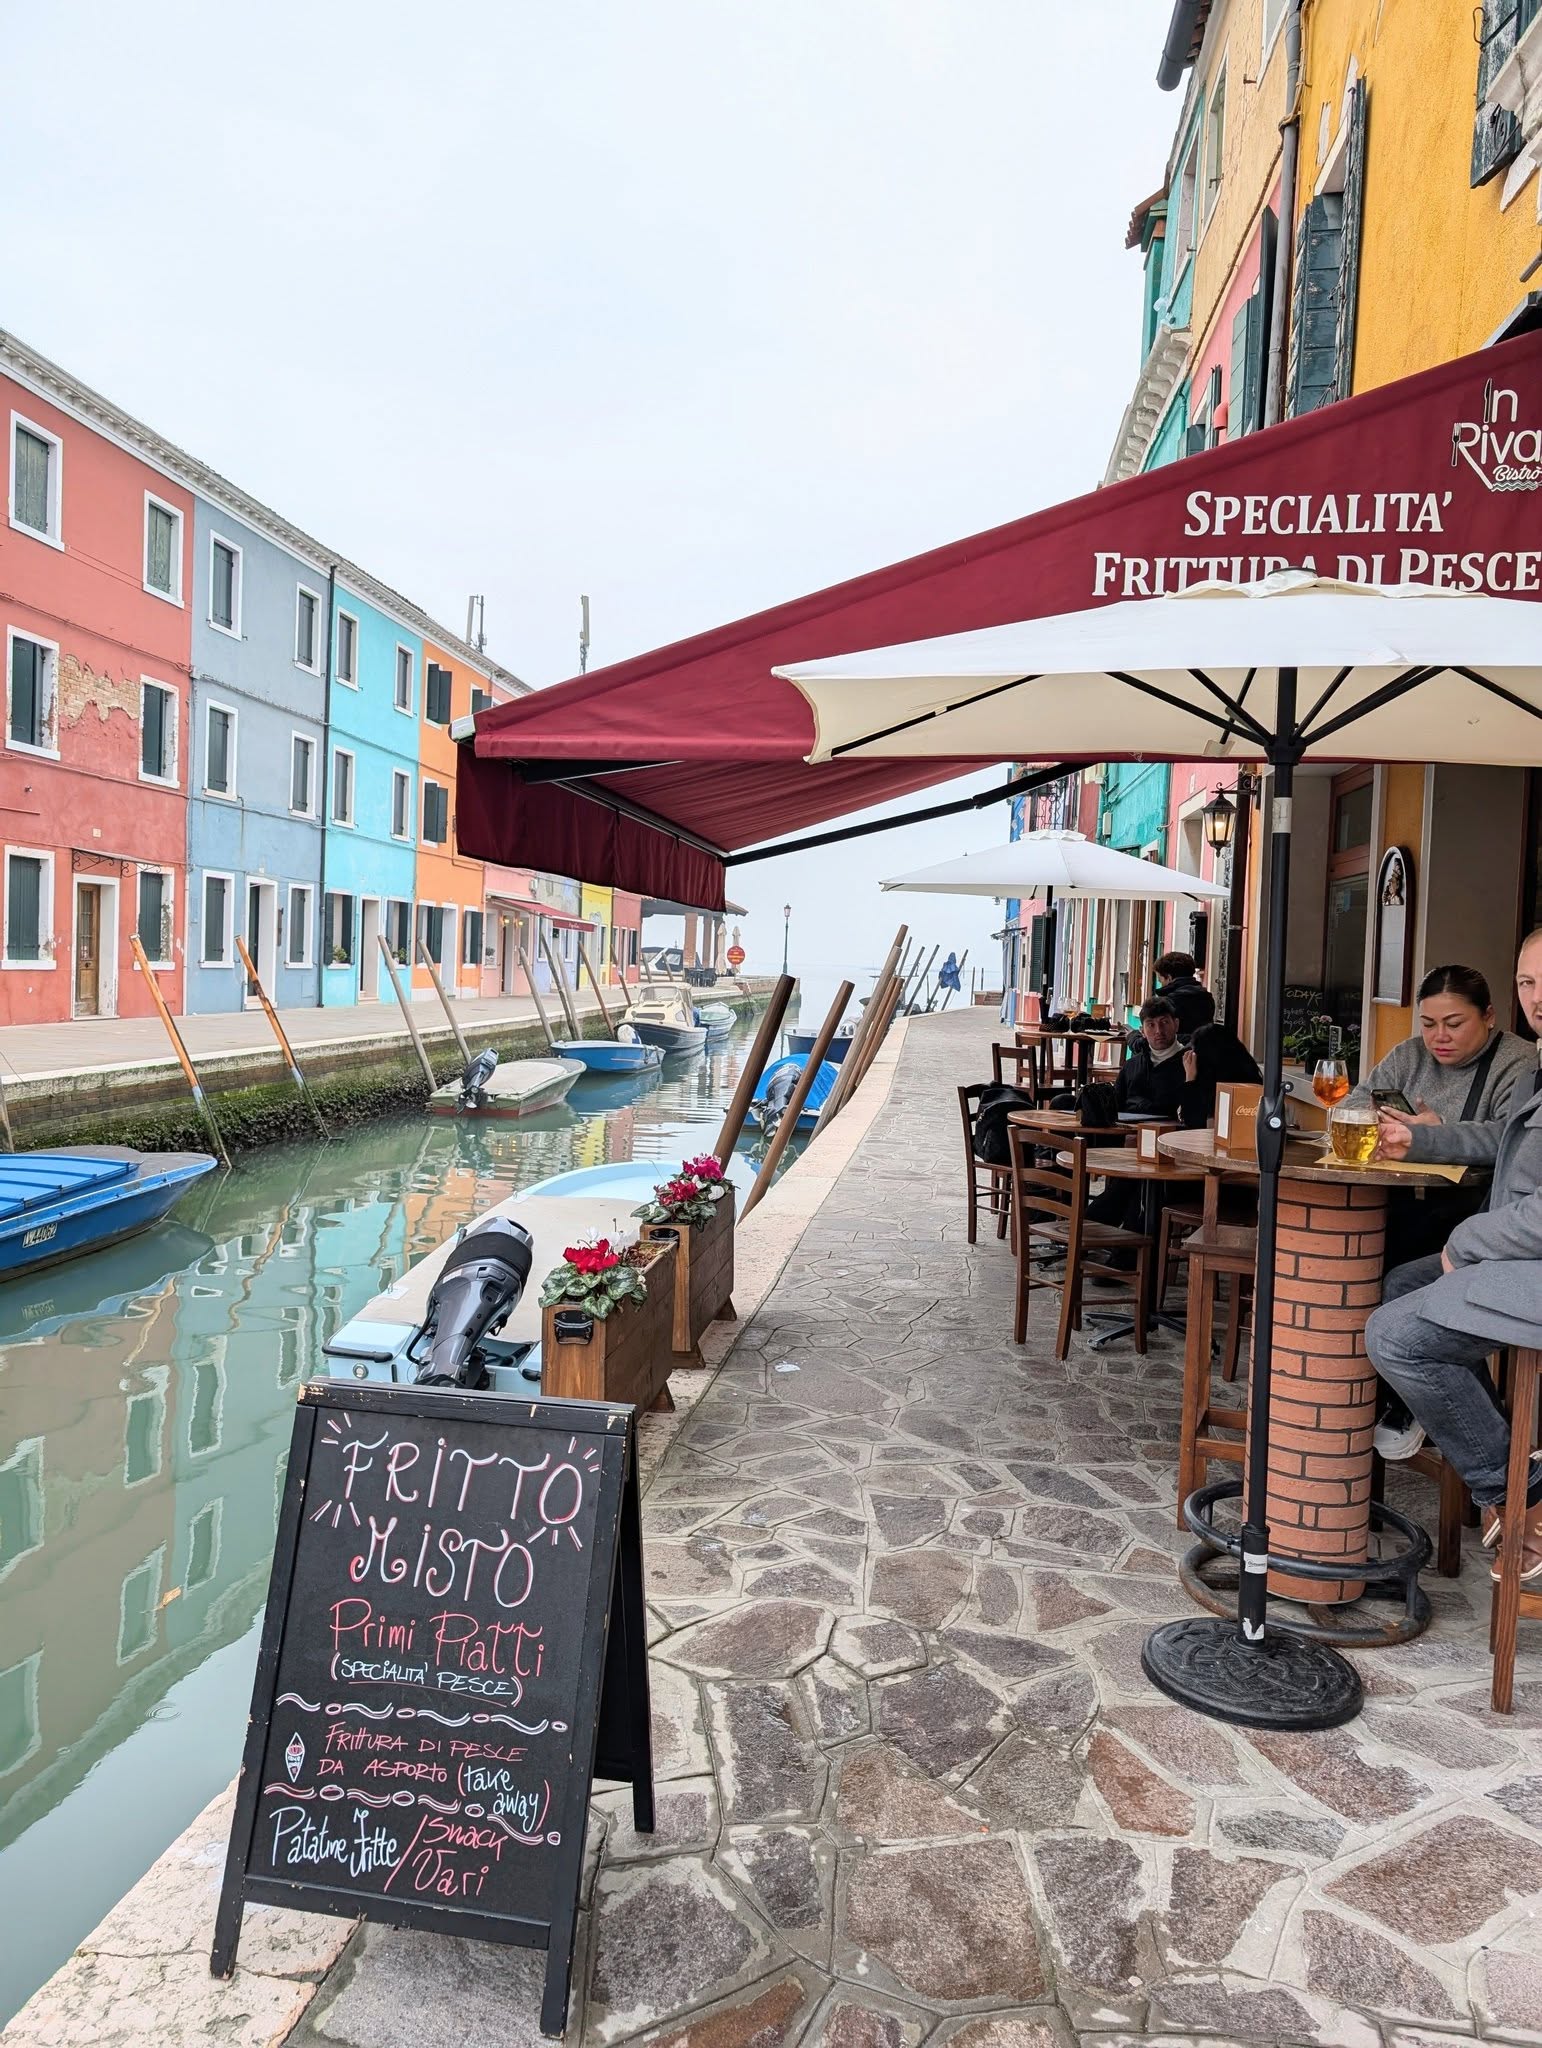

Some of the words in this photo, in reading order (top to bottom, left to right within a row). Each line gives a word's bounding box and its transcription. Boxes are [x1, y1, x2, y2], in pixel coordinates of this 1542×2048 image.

[1492, 464, 1542, 482] Bistrò
[1336, 554, 1386, 586] DI
[1399, 548, 1542, 592] PESCE
[329, 1598, 416, 1655] Primi
[428, 1610, 545, 1677] Piatti
[316, 1759, 344, 1775] DA
[418, 1739, 441, 1753] DI
[269, 1806, 349, 1867] Patatine
[411, 1848, 490, 1896] Vari
